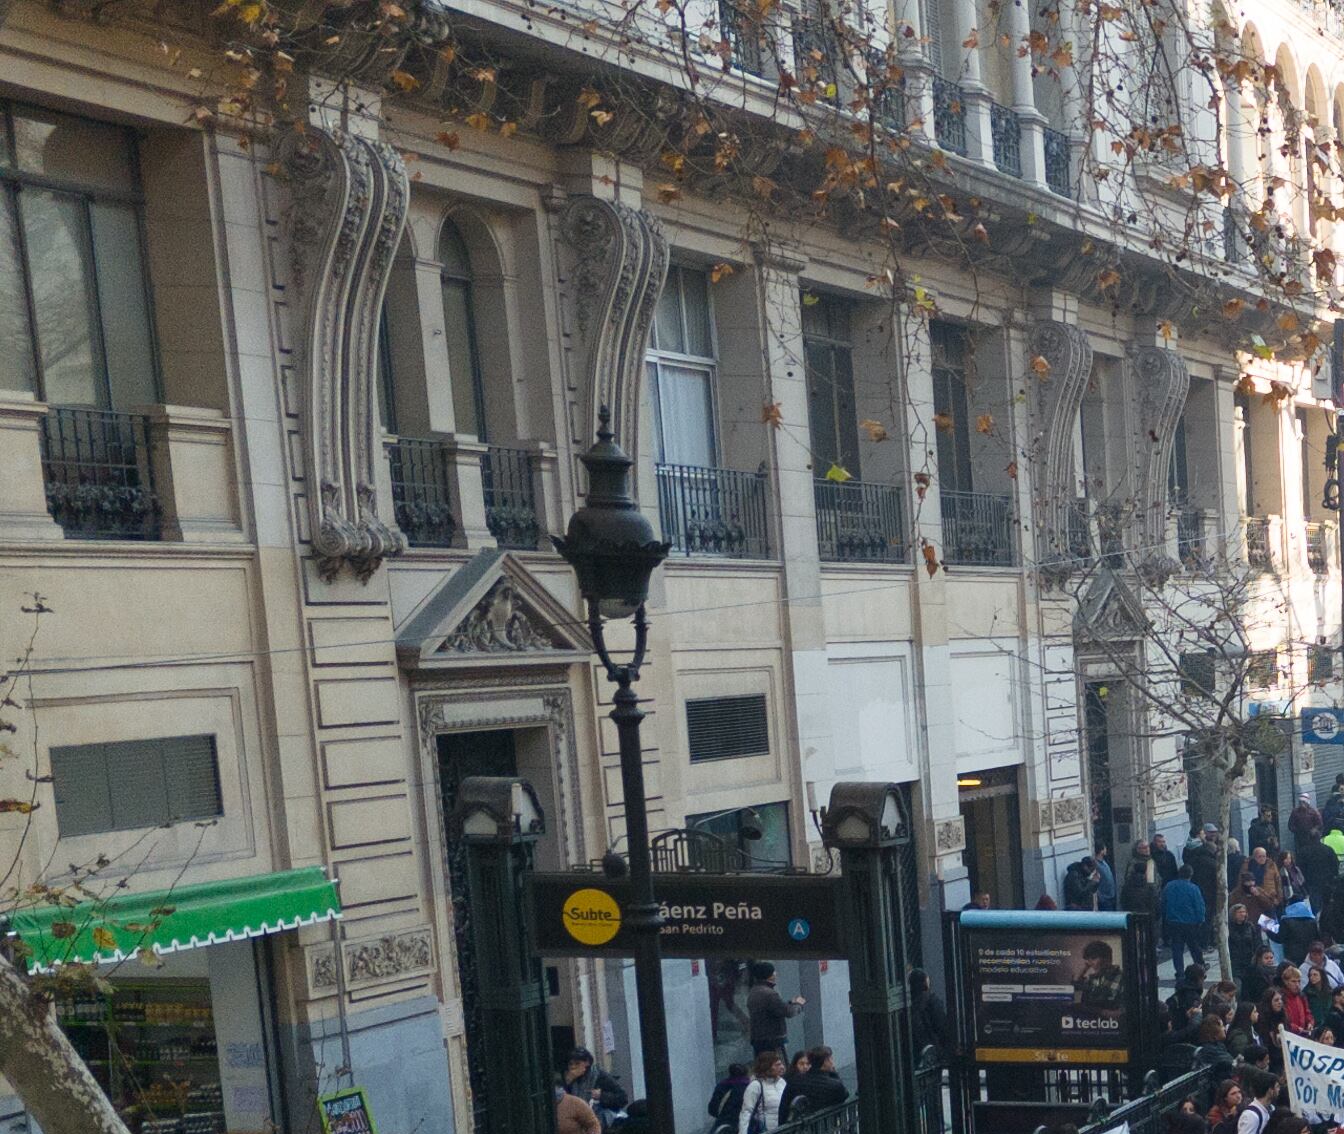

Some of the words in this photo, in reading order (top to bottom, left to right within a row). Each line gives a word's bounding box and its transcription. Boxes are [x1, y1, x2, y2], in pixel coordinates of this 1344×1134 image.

[569, 907, 612, 921] Subte
[658, 901, 706, 920] áenz
[713, 901, 763, 920] Peña
[682, 923, 724, 936] Pedrito
[792, 921, 805, 936] A
[1075, 1017, 1119, 1029] teclab
